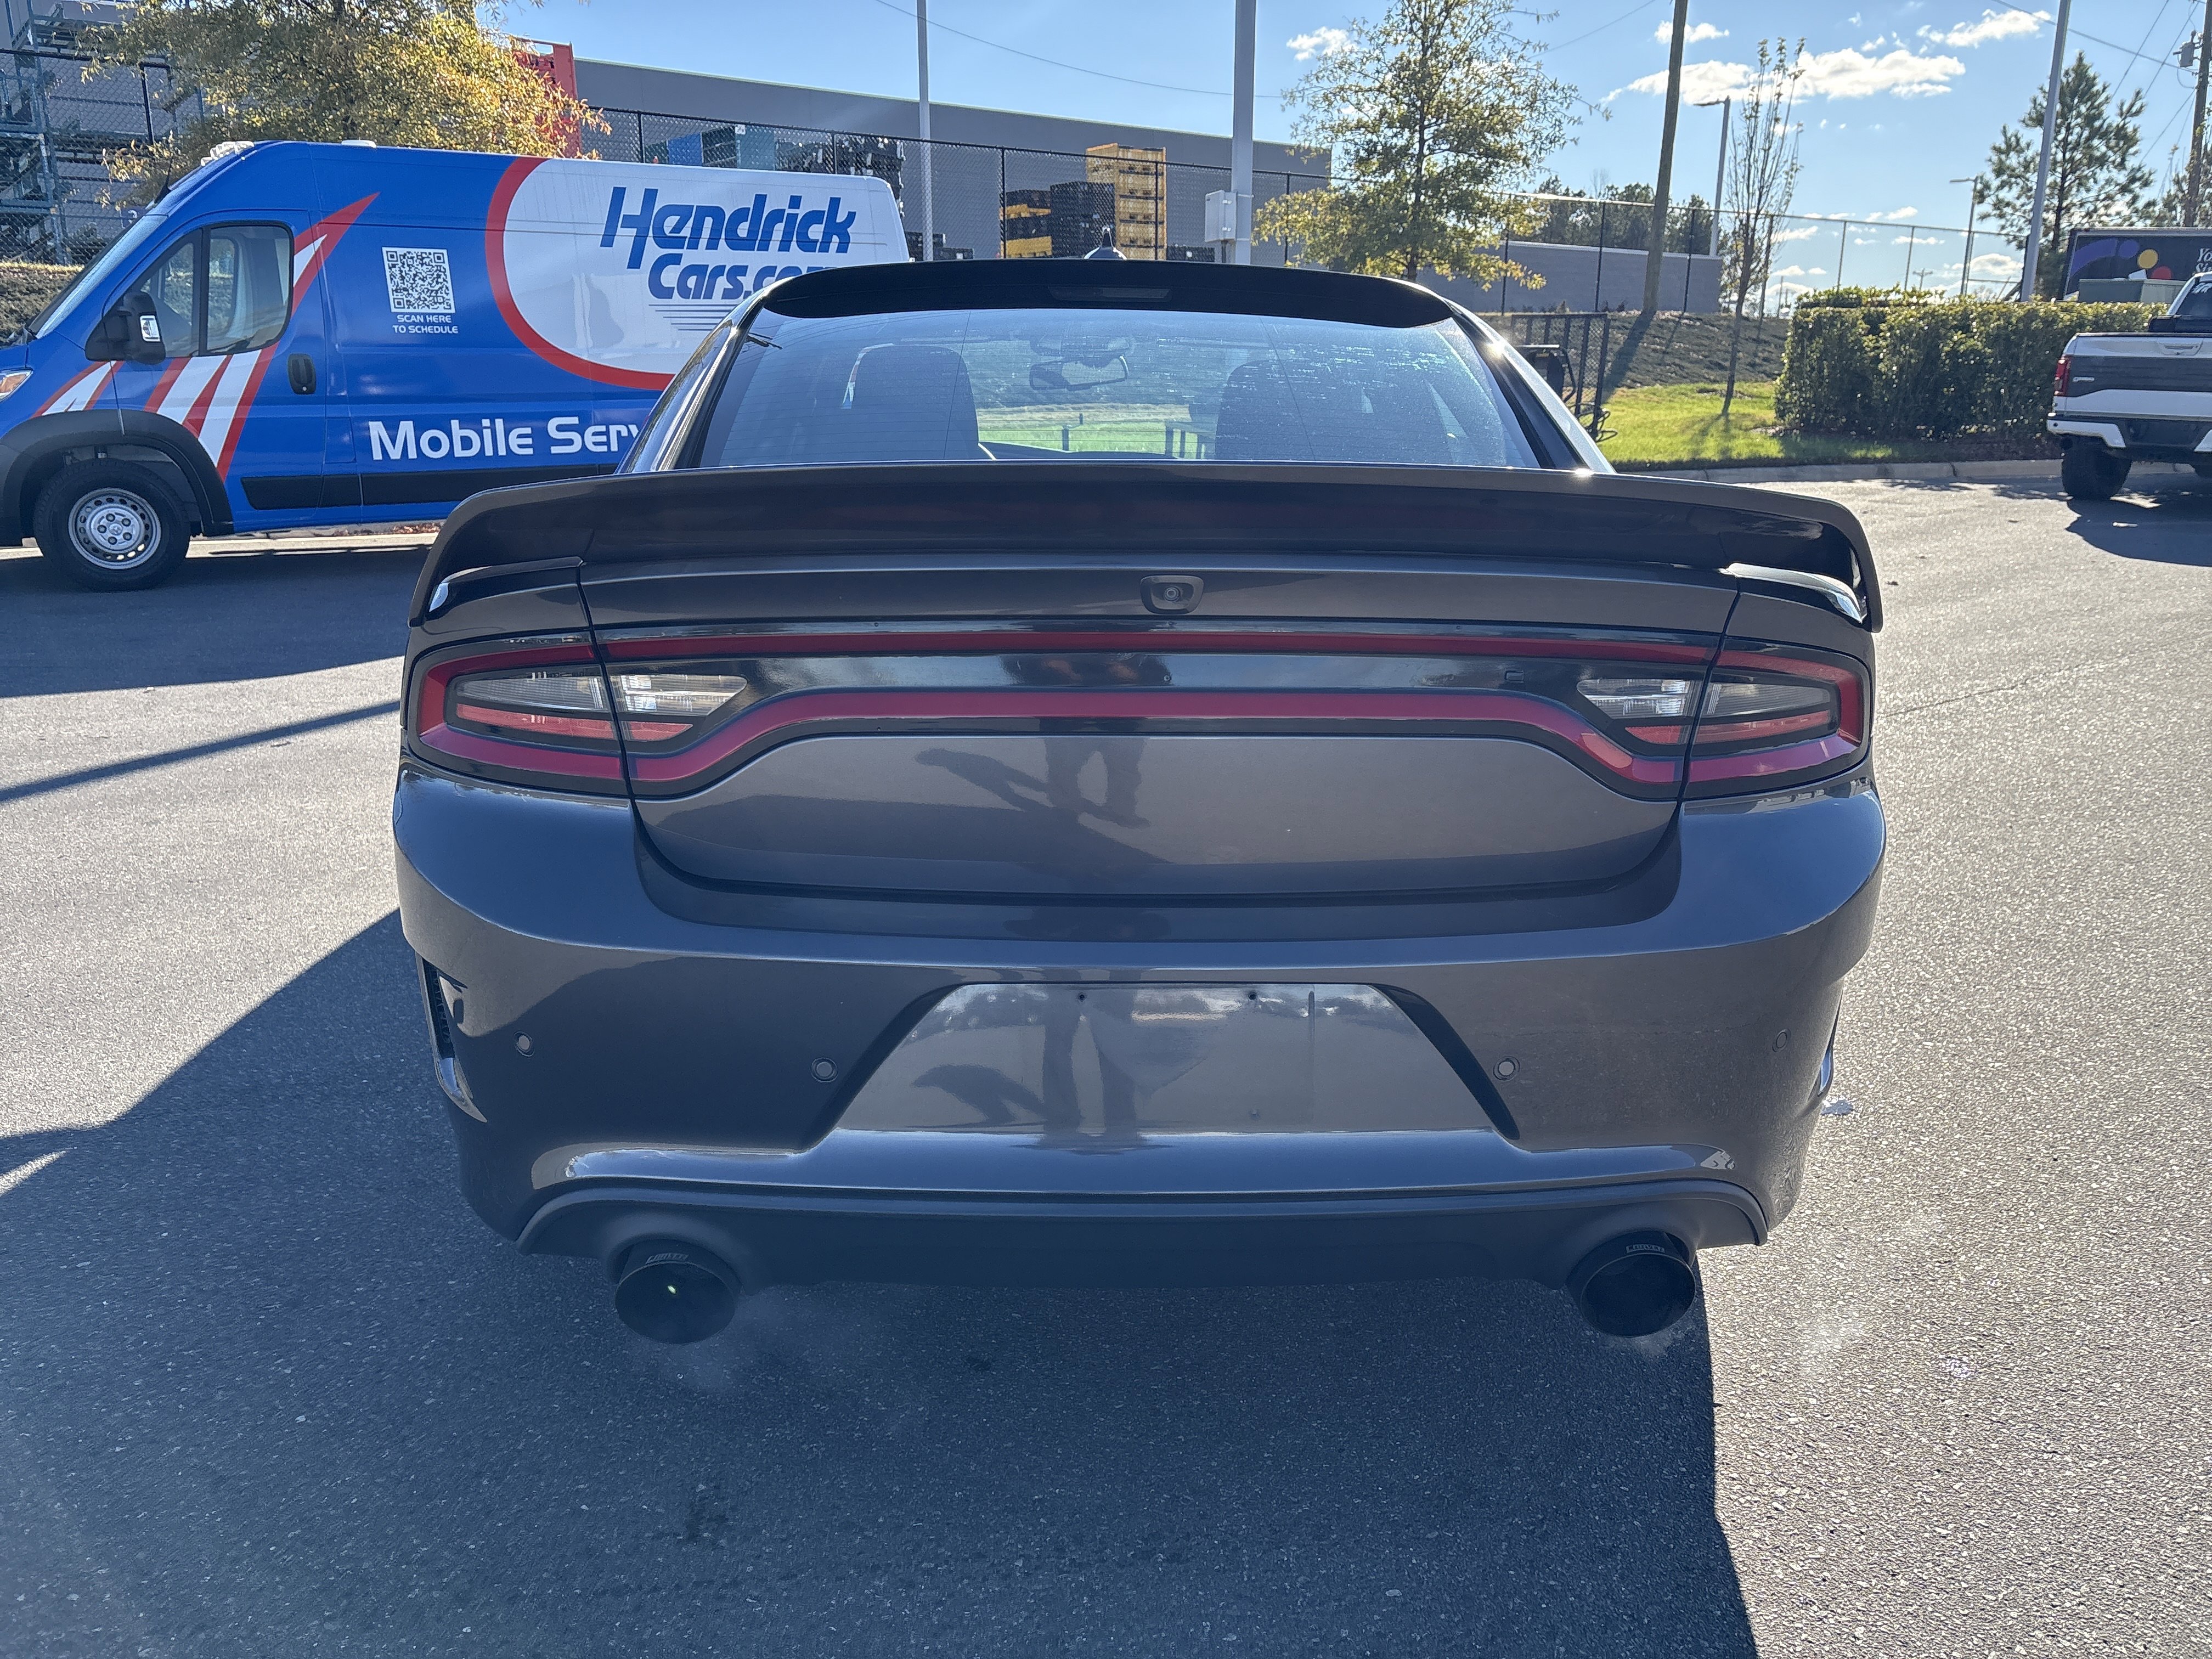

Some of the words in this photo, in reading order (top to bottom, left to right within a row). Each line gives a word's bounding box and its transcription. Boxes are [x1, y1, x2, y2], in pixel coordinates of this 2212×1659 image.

[600, 186, 856, 269] Hendrick
[648, 253, 836, 300] Cars.c
[392, 325, 407, 334] TO
[408, 325, 459, 334] SCHEDULE
[397, 314, 424, 323] SCAN
[426, 315, 452, 323] HERE
[368, 419, 534, 460] Mobile
